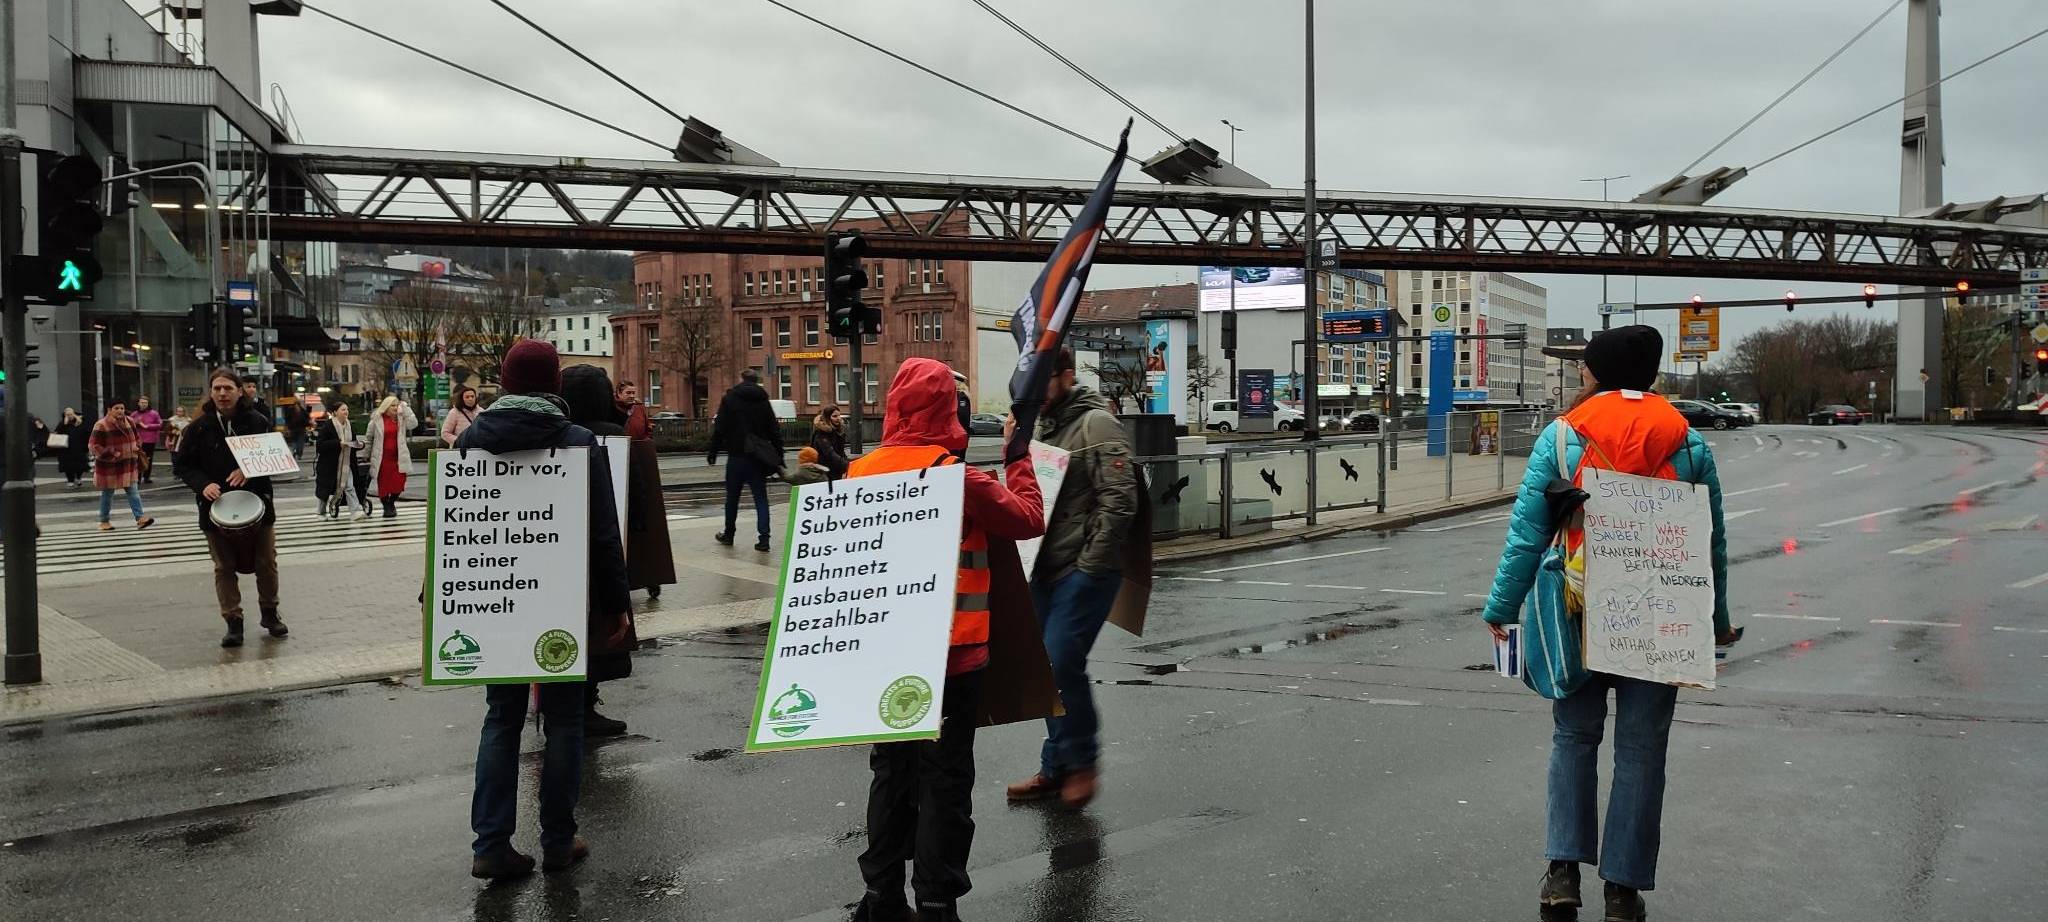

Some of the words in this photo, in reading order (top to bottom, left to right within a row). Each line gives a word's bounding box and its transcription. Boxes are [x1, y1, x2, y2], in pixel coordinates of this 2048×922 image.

[445, 459, 486, 477] Stell
[495, 459, 523, 476] Dir
[530, 465, 566, 477] vor,
[445, 485, 501, 499] Deine
[804, 494, 847, 511] Statt
[856, 482, 928, 504] fossiler
[1600, 481, 1653, 498] STELL
[1658, 486, 1687, 503] DIR
[445, 506, 509, 522] Kinder
[518, 504, 553, 521] und
[799, 508, 939, 535] Subventionen
[444, 528, 497, 545] Enkel
[505, 527, 558, 544] leben
[1586, 515, 1609, 528] DIE
[1612, 517, 1646, 531] LUFT
[1655, 522, 1690, 537] WÄRE
[798, 544, 837, 559] Bus-
[846, 532, 883, 553] und
[1592, 528, 1642, 542] SAUBER
[1655, 534, 1685, 548] UND
[444, 554, 459, 568] in
[468, 553, 518, 568] einer
[793, 560, 889, 583] Bahnnetz
[442, 573, 539, 596] gesunden
[788, 586, 887, 608] ausbauen
[897, 574, 935, 595] und
[443, 597, 514, 615] Umwelt
[1646, 595, 1677, 614] FEB
[784, 608, 889, 632] bezahlbar
[781, 636, 859, 657] machen
[1609, 636, 1657, 652] RATHAUS
[1645, 649, 1696, 666] BARMEN
